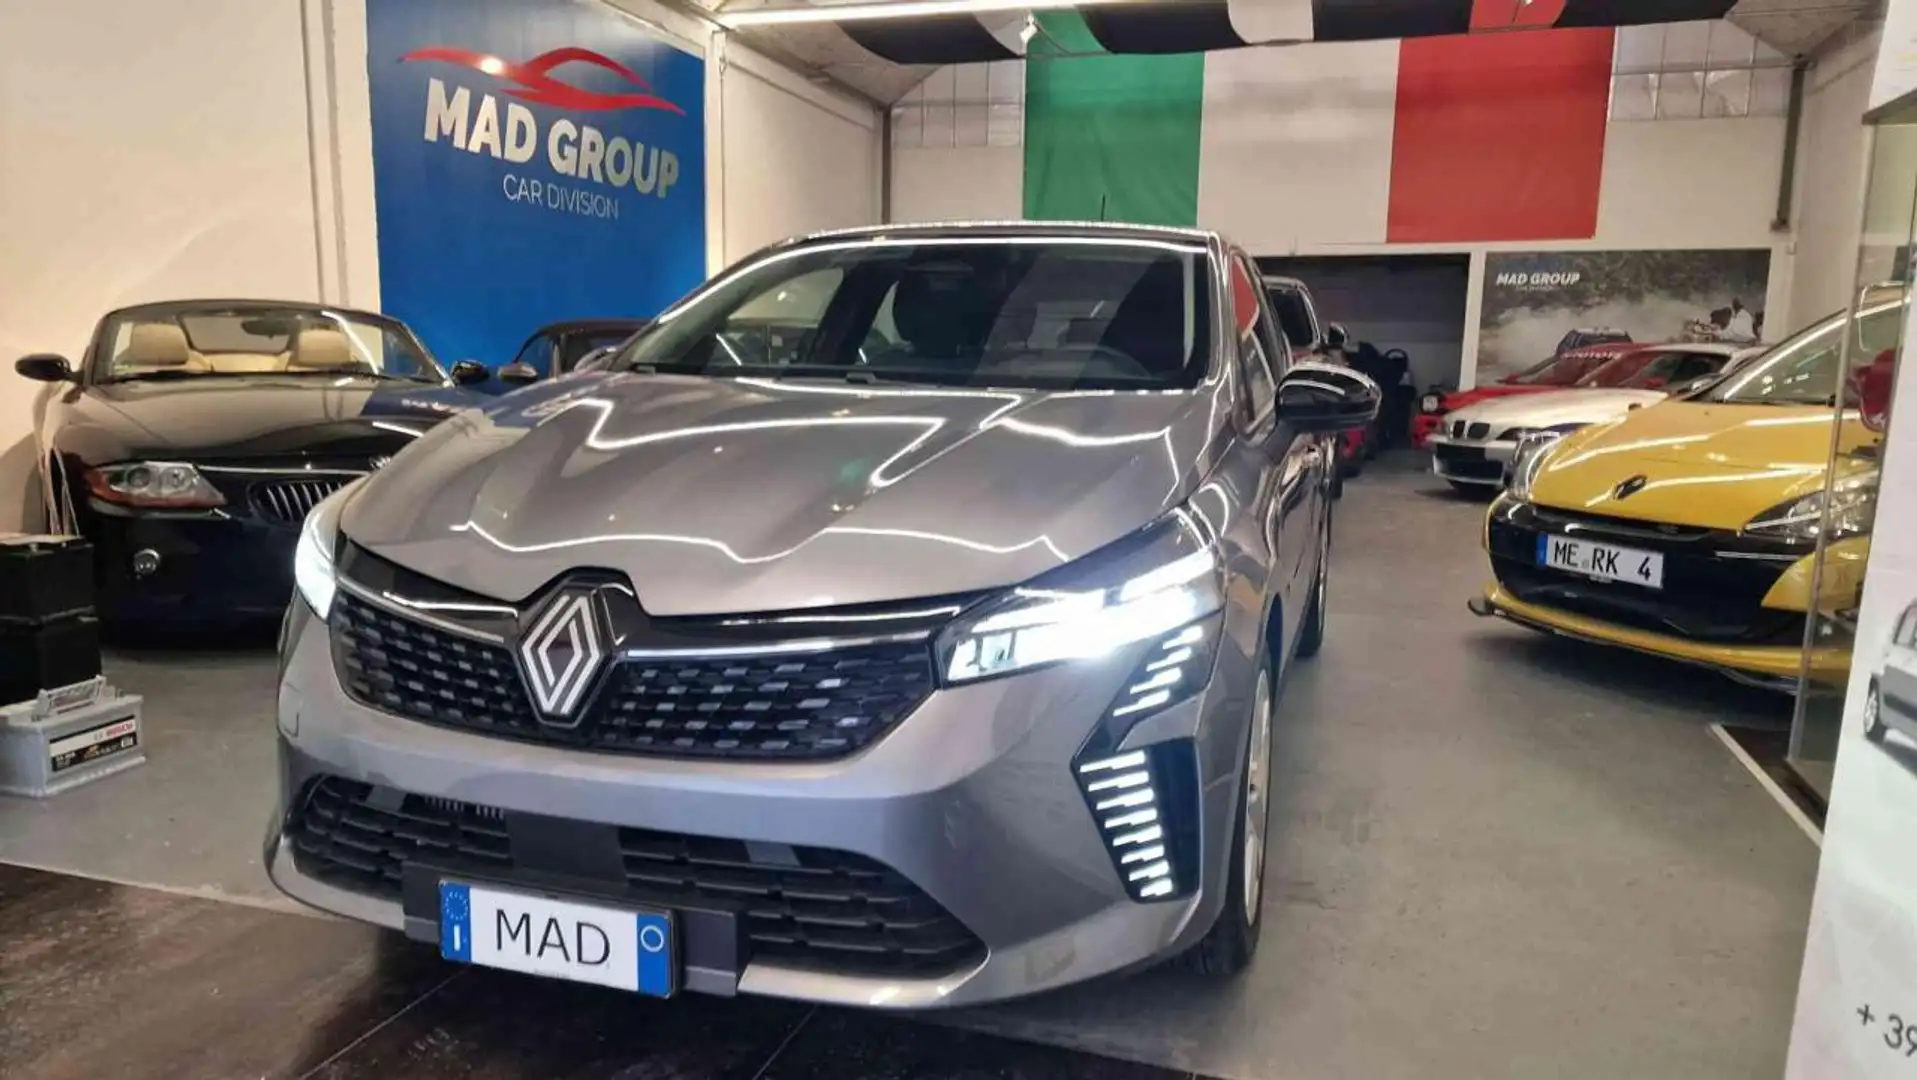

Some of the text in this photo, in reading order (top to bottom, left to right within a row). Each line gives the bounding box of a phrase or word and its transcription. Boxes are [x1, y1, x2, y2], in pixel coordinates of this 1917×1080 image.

[424, 78, 680, 199] MAD GROUP
[503, 174, 620, 220] CAR DIVISION
[1496, 272, 1580, 286] MAD GROUP
[1554, 540, 1651, 581] ME RK 4
[496, 908, 611, 966] MAD
